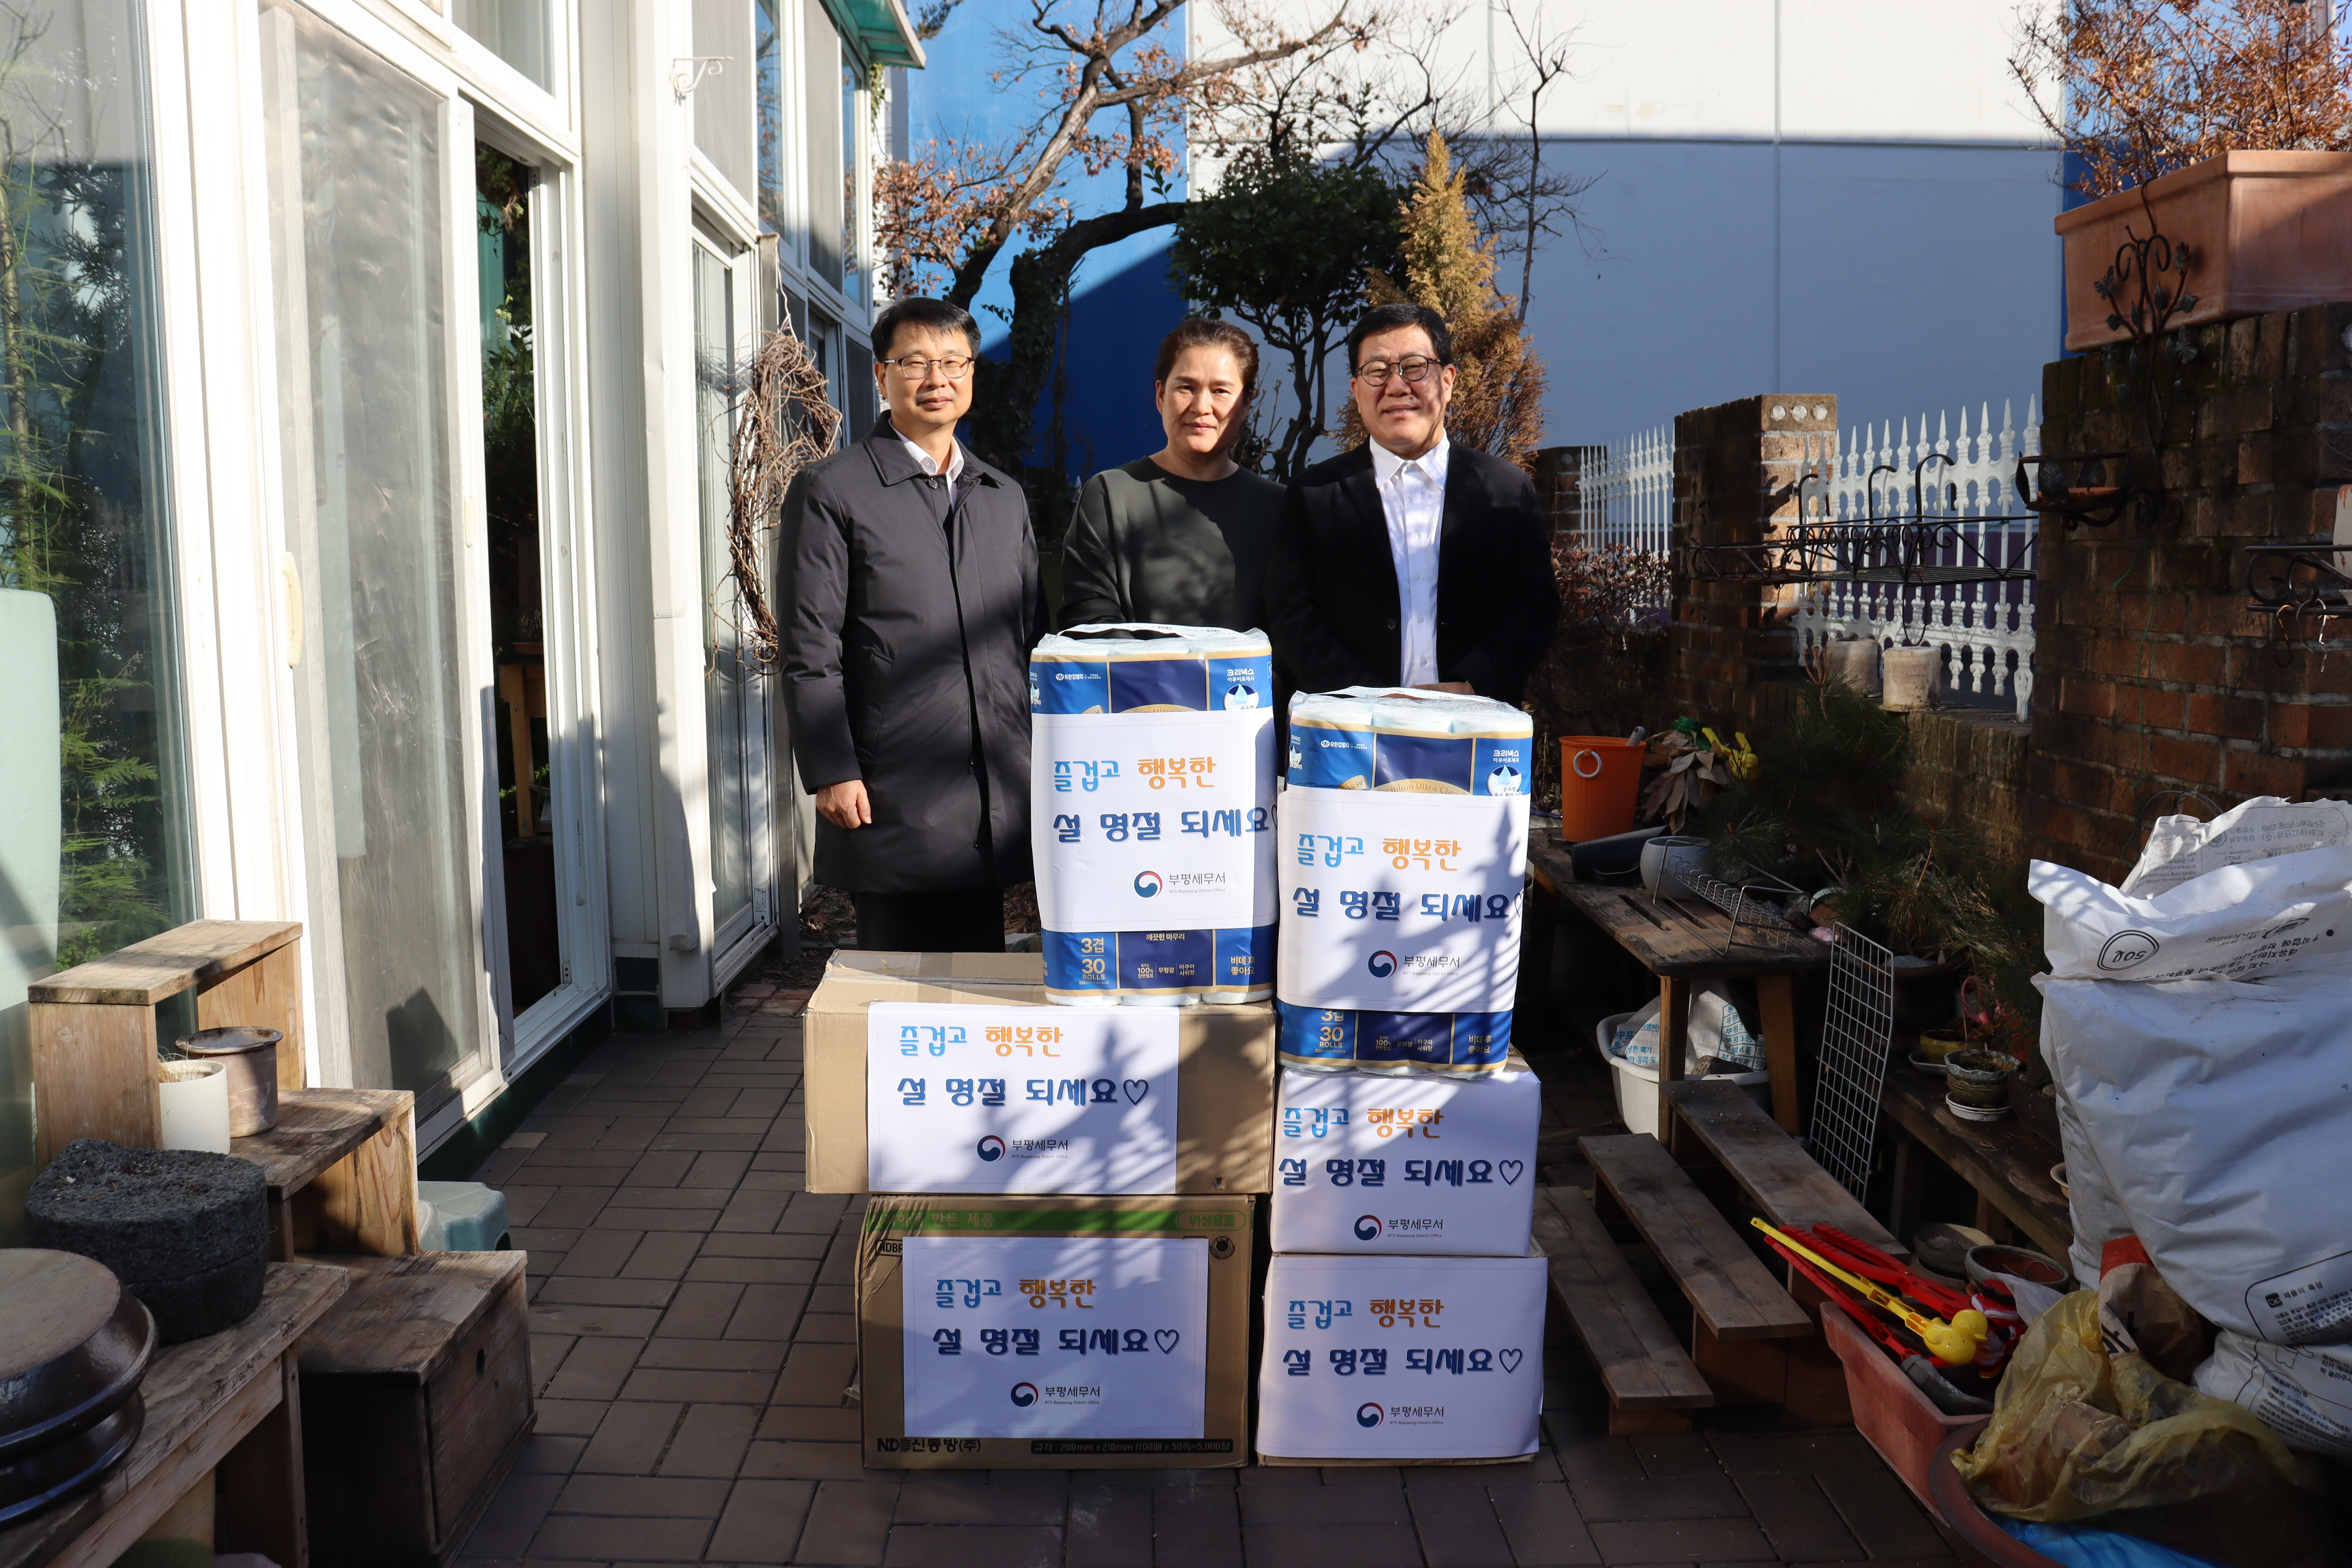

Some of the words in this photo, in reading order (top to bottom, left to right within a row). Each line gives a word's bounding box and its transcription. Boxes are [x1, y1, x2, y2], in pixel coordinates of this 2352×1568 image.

[1053, 760, 1120, 791] 즐겁고
[1138, 757, 1216, 789] 행복한
[1416, 782, 1438, 792] Ultra
[1053, 814, 1080, 842] 설
[1100, 812, 1160, 841] 명절
[1181, 807, 1269, 838] 되세요
[1297, 833, 1364, 867] 즐겁고
[1383, 837, 1461, 871] 행복한
[1169, 873, 1225, 885] 부평세무서
[1293, 887, 1320, 916] 설
[1340, 891, 1399, 921] 명절
[1421, 893, 1509, 921] 되세요
[1081, 937, 1104, 953] 3겹
[1082, 958, 1105, 974] 30
[1230, 956, 1246, 965] 비데
[1247, 956, 1255, 964] 후
[1403, 955, 1460, 968] 부평세무서
[1230, 966, 1254, 976] 좋아요
[900, 1025, 966, 1056] 즐겁고
[985, 1025, 1063, 1057] 행복한
[1319, 1027, 1344, 1042] 30
[1468, 1035, 1483, 1044] 비데
[1485, 1035, 1492, 1044] 후
[1468, 1045, 1491, 1054] 좋아요
[897, 1078, 926, 1105] 설
[946, 1078, 1005, 1106] 명절
[1025, 1078, 1118, 1106] 되세요
[1283, 1107, 1349, 1137] 즐겁고
[1367, 1108, 1444, 1138] 행복한
[1012, 1138, 1068, 1151] 부평세무서
[1279, 1158, 1306, 1185] 설
[1326, 1159, 1385, 1186] 명절
[1404, 1159, 1493, 1185] 되세요
[931, 1213, 959, 1227] 만든
[967, 1212, 995, 1227] 제품
[1189, 1214, 1235, 1227] 위생용품
[1388, 1218, 1443, 1230] 부평세무서
[936, 1279, 1001, 1308] 즐겁고
[1018, 1279, 1096, 1308] 행복한
[2283, 1287, 2305, 1298] 제품의
[2308, 1281, 2323, 1290] 특성
[1287, 1300, 1352, 1329] 즐겁고
[1370, 1299, 1444, 1328] 행복한
[933, 1328, 960, 1354] 설
[980, 1328, 1039, 1354] 명절
[1058, 1328, 1149, 1354] 되세요
[1283, 1349, 1310, 1376] 설
[1330, 1348, 1387, 1375] 명절
[1406, 1348, 1493, 1374] 되세요
[1044, 1385, 1100, 1397] 부평세무서
[1390, 1405, 1444, 1417] 부평세무서
[1034, 1443, 1052, 1452] 규격
[1061, 1443, 1093, 1452] 200mm
[1103, 1443, 1132, 1452] 210mm
